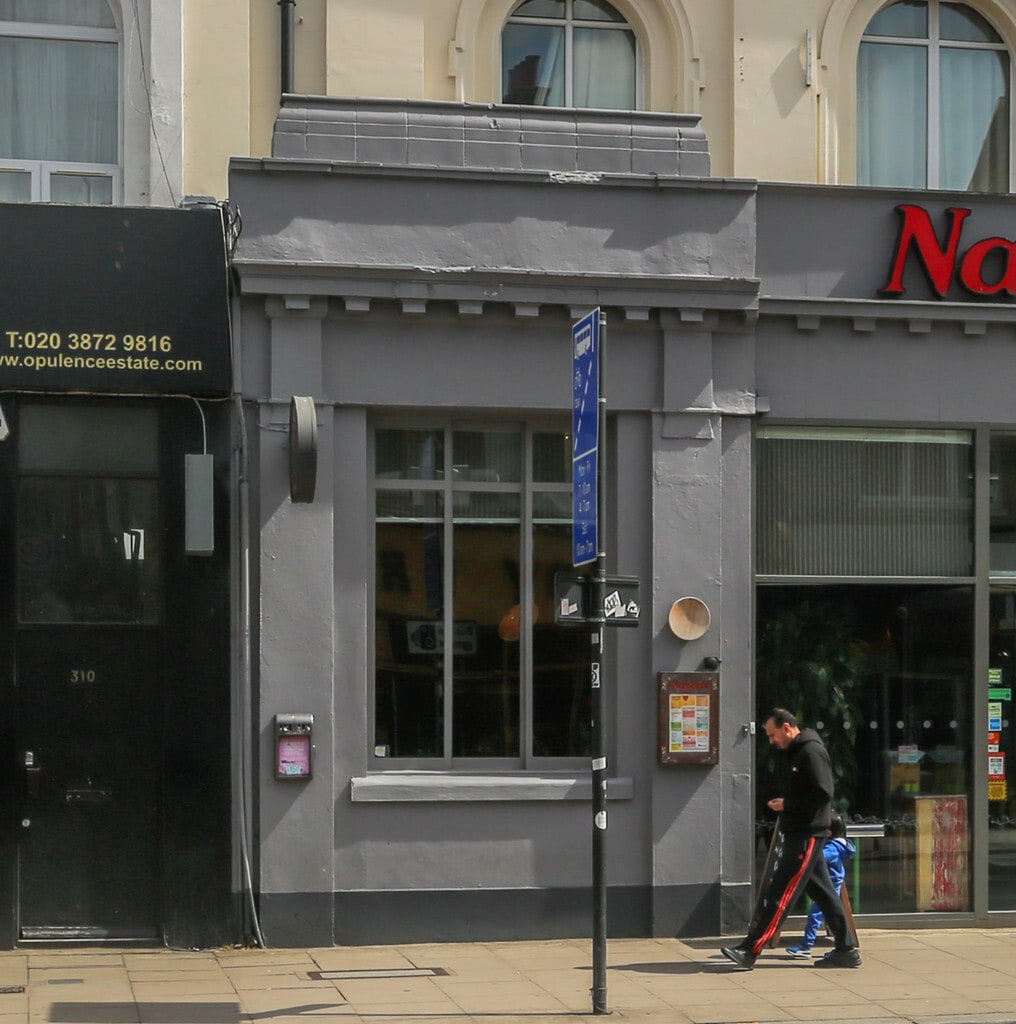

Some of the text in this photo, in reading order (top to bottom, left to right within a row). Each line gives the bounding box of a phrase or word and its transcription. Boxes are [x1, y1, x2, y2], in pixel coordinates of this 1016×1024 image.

[6, 331, 172, 352] T:020 3872 9816
[71, 670, 95, 682] 310
